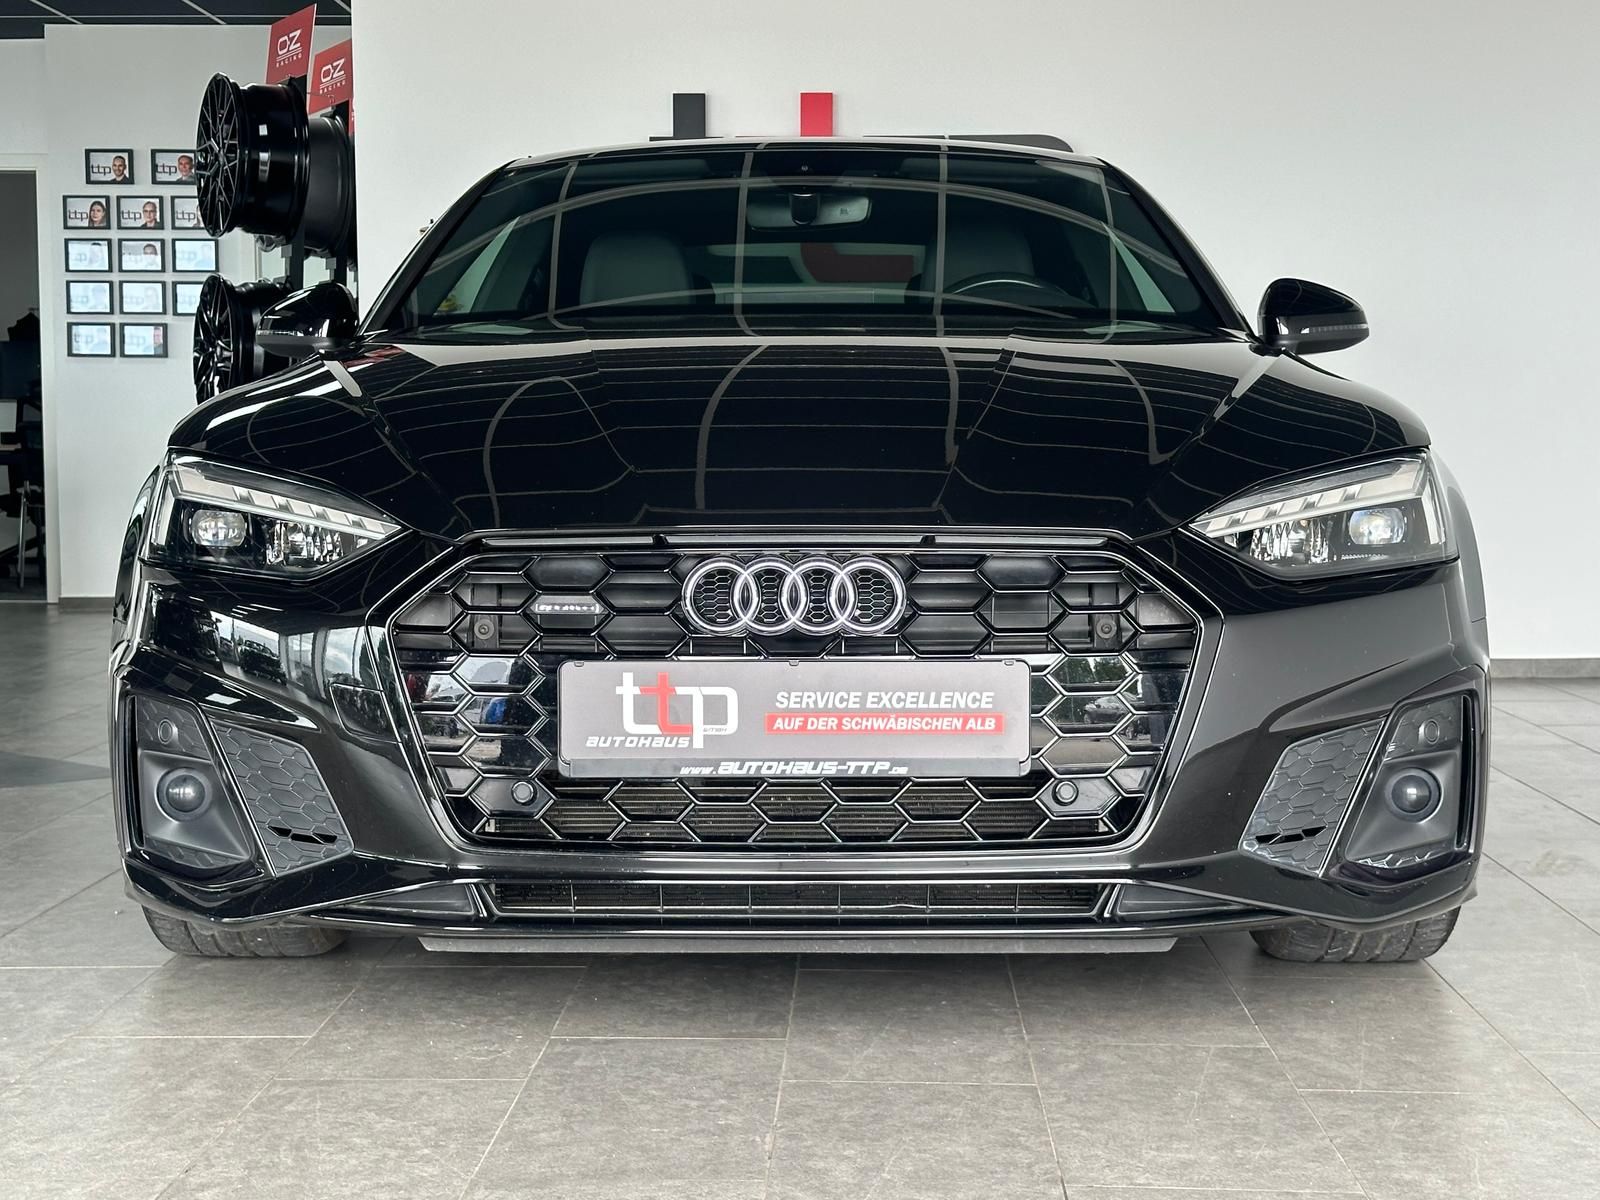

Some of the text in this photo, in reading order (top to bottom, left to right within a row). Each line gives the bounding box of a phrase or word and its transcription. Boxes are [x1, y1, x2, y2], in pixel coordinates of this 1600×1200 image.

[277, 29, 301, 54] OZ
[321, 58, 345, 82] OZ
[775, 691, 995, 709] SERVICE EXCELLENCE
[772, 714, 996, 730] AUF DER SCHWÄBISCHEN ALB
